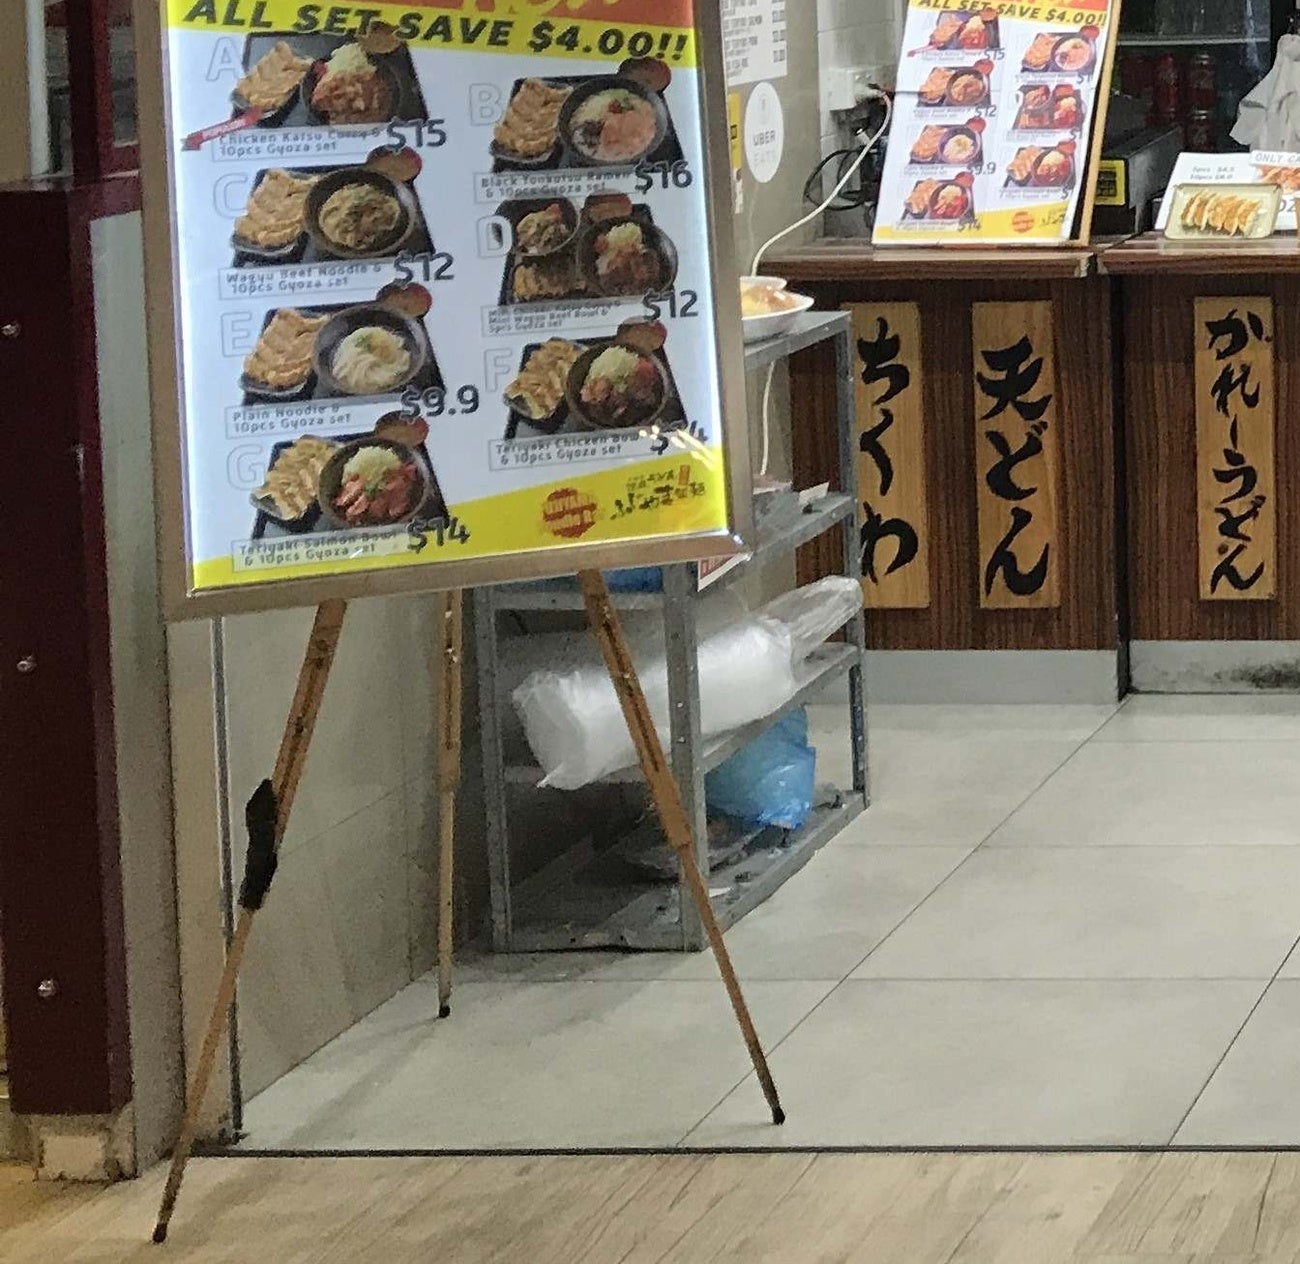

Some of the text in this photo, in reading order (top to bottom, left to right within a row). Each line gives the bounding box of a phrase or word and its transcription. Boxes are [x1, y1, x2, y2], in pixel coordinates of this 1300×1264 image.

[959, 0, 989, 11] SET
[995, 3, 1041, 20] SAVE
[293, 3, 383, 37] SET
[393, 11, 514, 48] SAVE
[528, 20, 688, 61] $4.00!!
[219, 141, 337, 158] 10pcs Gyoza set
[386, 116, 447, 153] $15
[1255, 153, 1282, 163] ONLY
[634, 158, 693, 194] $16
[226, 271, 275, 285] Wagyu
[280, 267, 312, 279] Beef
[392, 250, 454, 287] $12
[232, 282, 273, 296] 10pcs
[278, 280, 322, 293] Gyoza
[641, 289, 700, 322] $12
[233, 405, 326, 422] Plain Noodle
[399, 384, 480, 420] $9.9
[234, 413, 351, 435] 10pcs Gyoza set
[513, 444, 622, 465] 10pcs Gyoza set
[858, 316, 919, 585] ちくわ
[975, 335, 1054, 597] 天どん
[1204, 308, 1274, 595] かれーうどん
[407, 515, 471, 554] $14
[259, 546, 350, 565] 10pcs Gyoza
